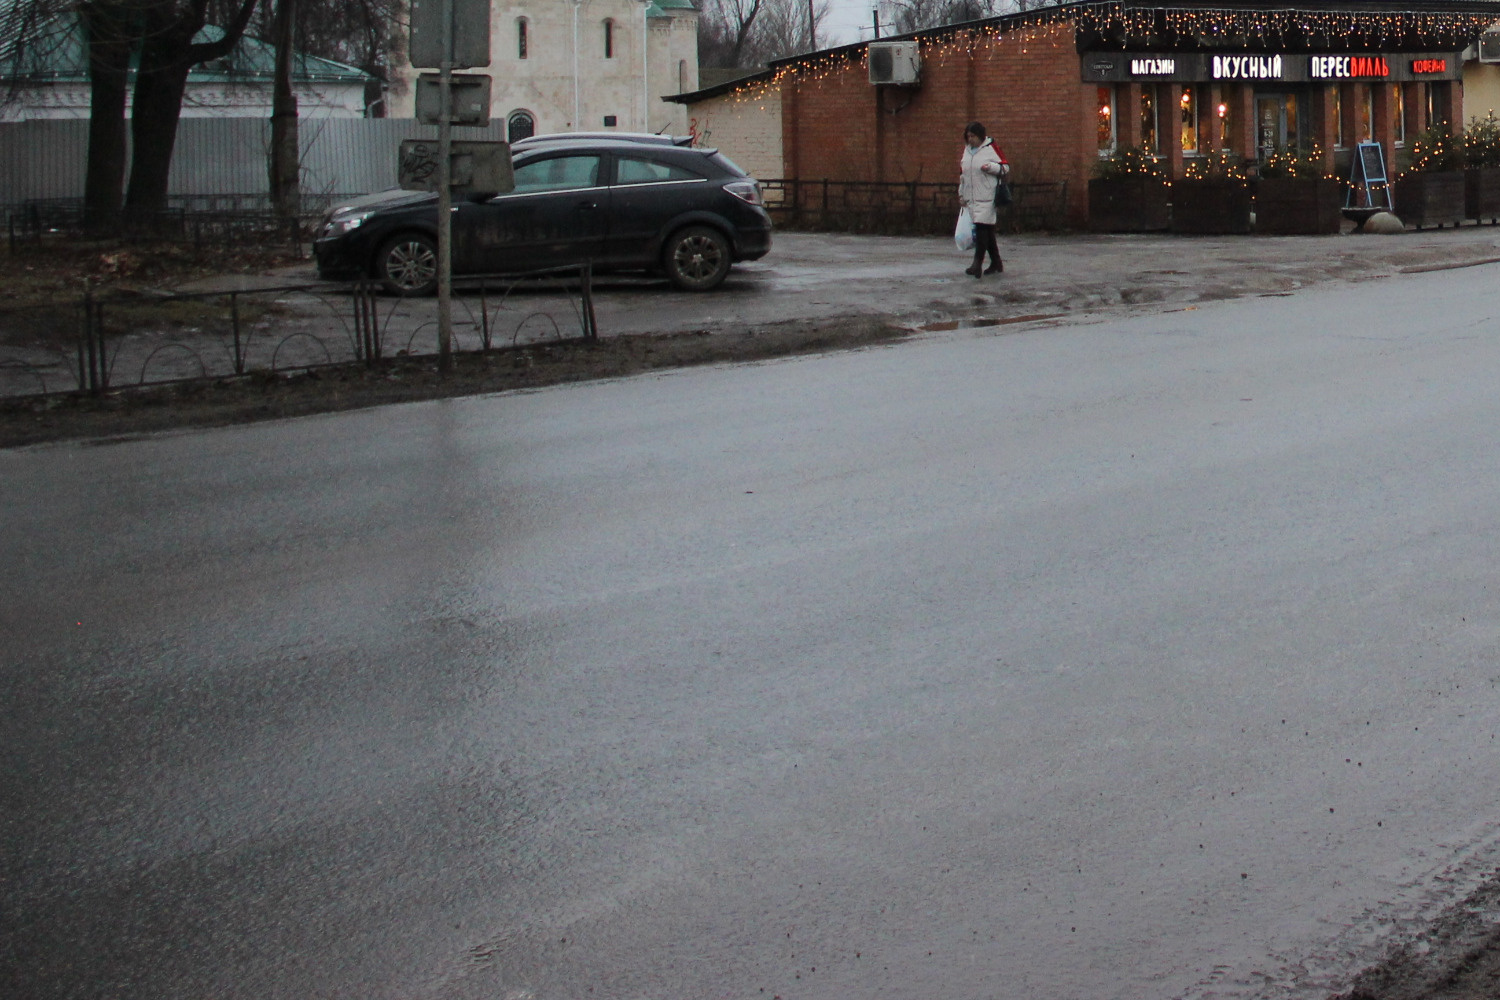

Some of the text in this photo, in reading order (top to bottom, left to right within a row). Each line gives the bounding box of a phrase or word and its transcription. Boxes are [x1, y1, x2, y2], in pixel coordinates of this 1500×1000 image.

[1131, 54, 1447, 79] МАГАЗИН ВКУСНЫЙ ПЕРЕСВИЛЛЬ КОФЕЙНЯ
